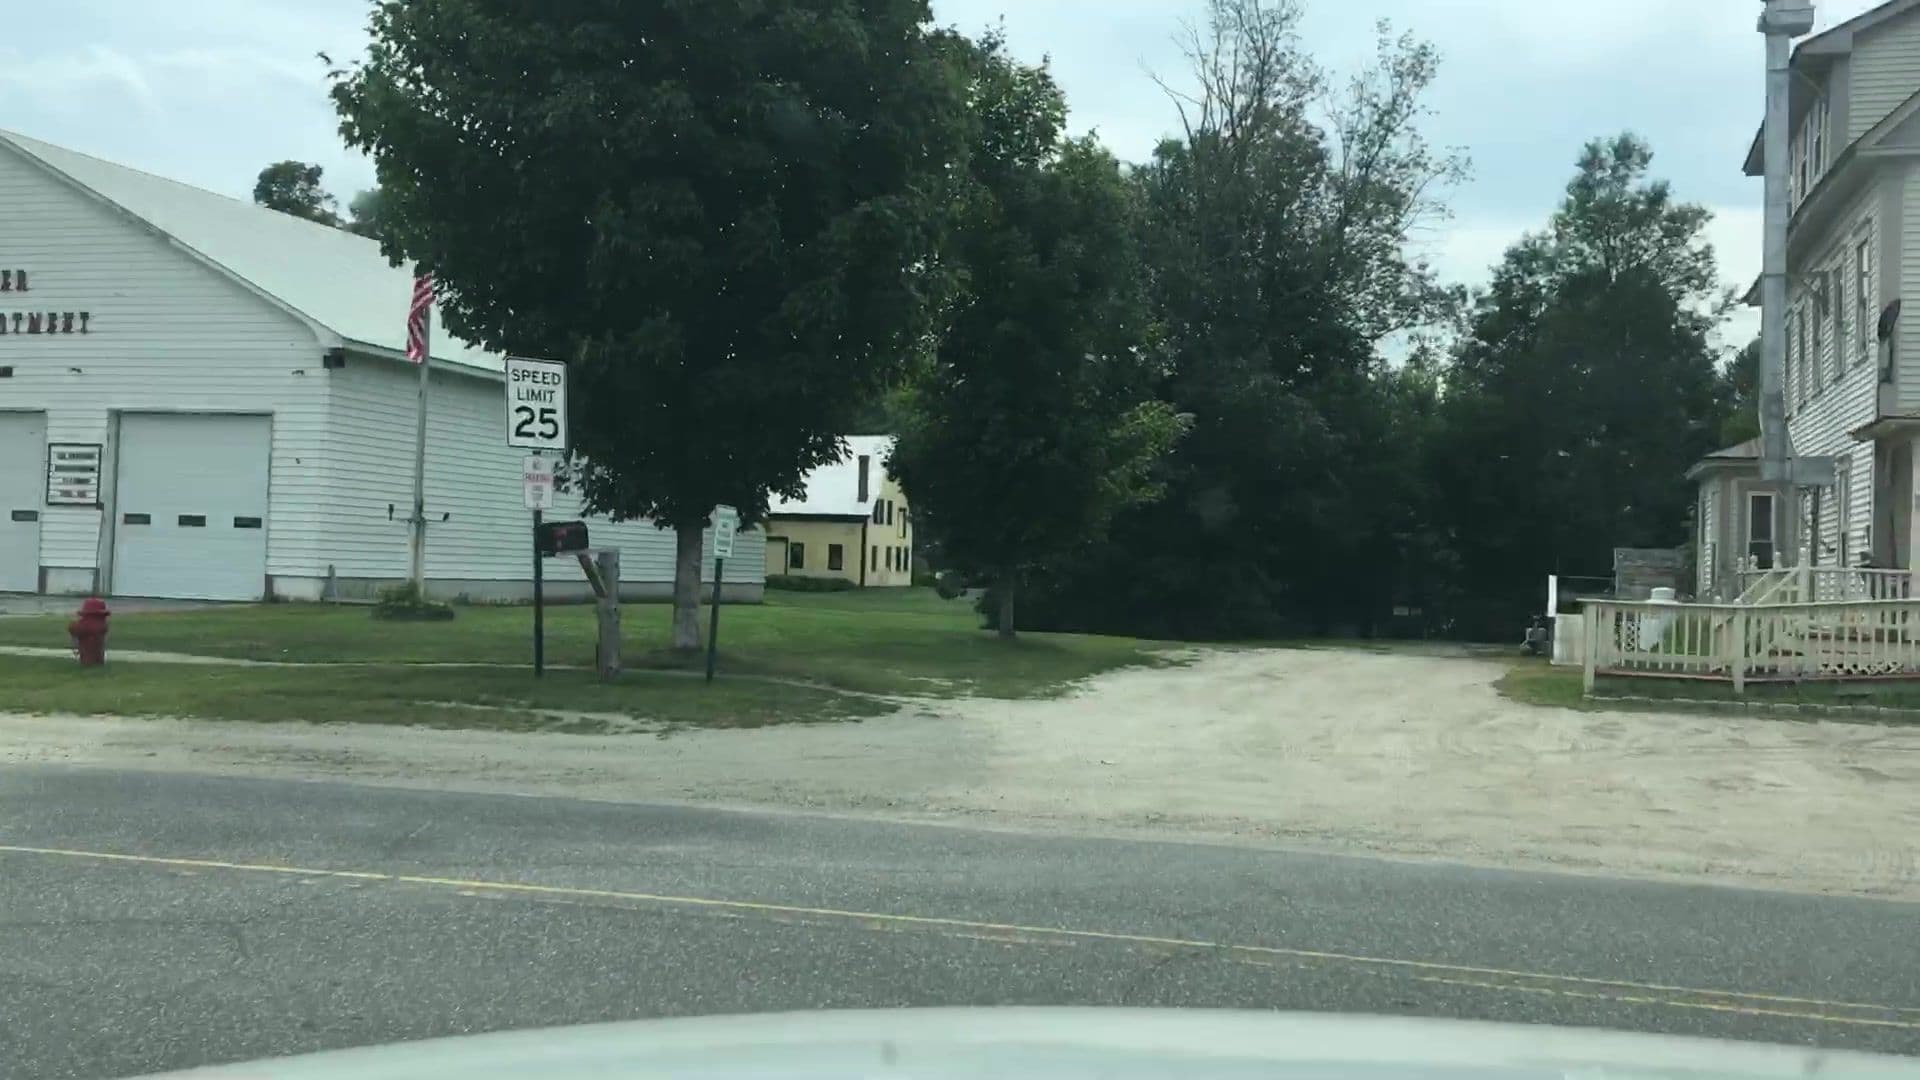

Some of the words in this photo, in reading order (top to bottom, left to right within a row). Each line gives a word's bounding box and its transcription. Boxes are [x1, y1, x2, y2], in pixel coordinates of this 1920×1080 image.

[511, 368, 561, 385] SPEED
[517, 387, 556, 403] LIMIT
[515, 405, 559, 439] 25
